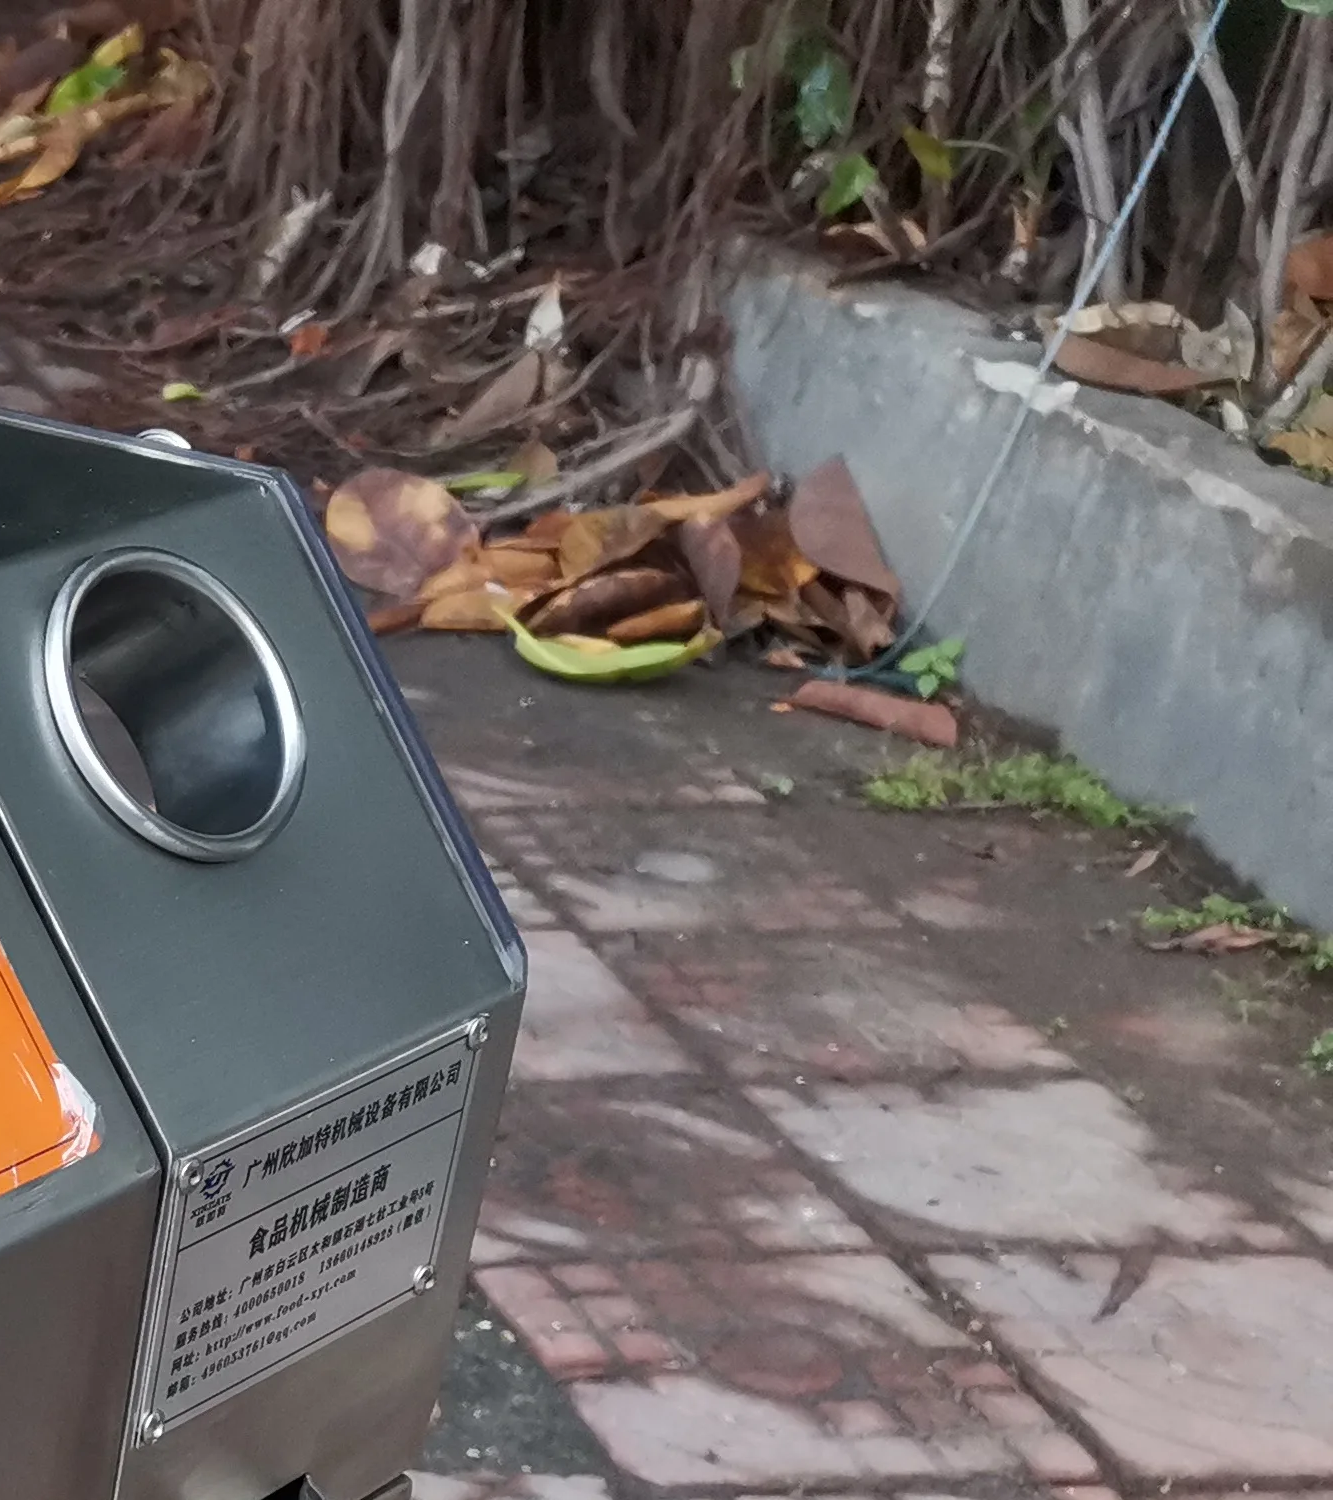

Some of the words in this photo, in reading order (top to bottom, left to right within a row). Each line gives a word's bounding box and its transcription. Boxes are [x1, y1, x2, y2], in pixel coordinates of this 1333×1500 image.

[242, 1059, 462, 1189] 广州欣加特机械设备有限公司
[248, 1163, 392, 1260] 食品机械制造商
